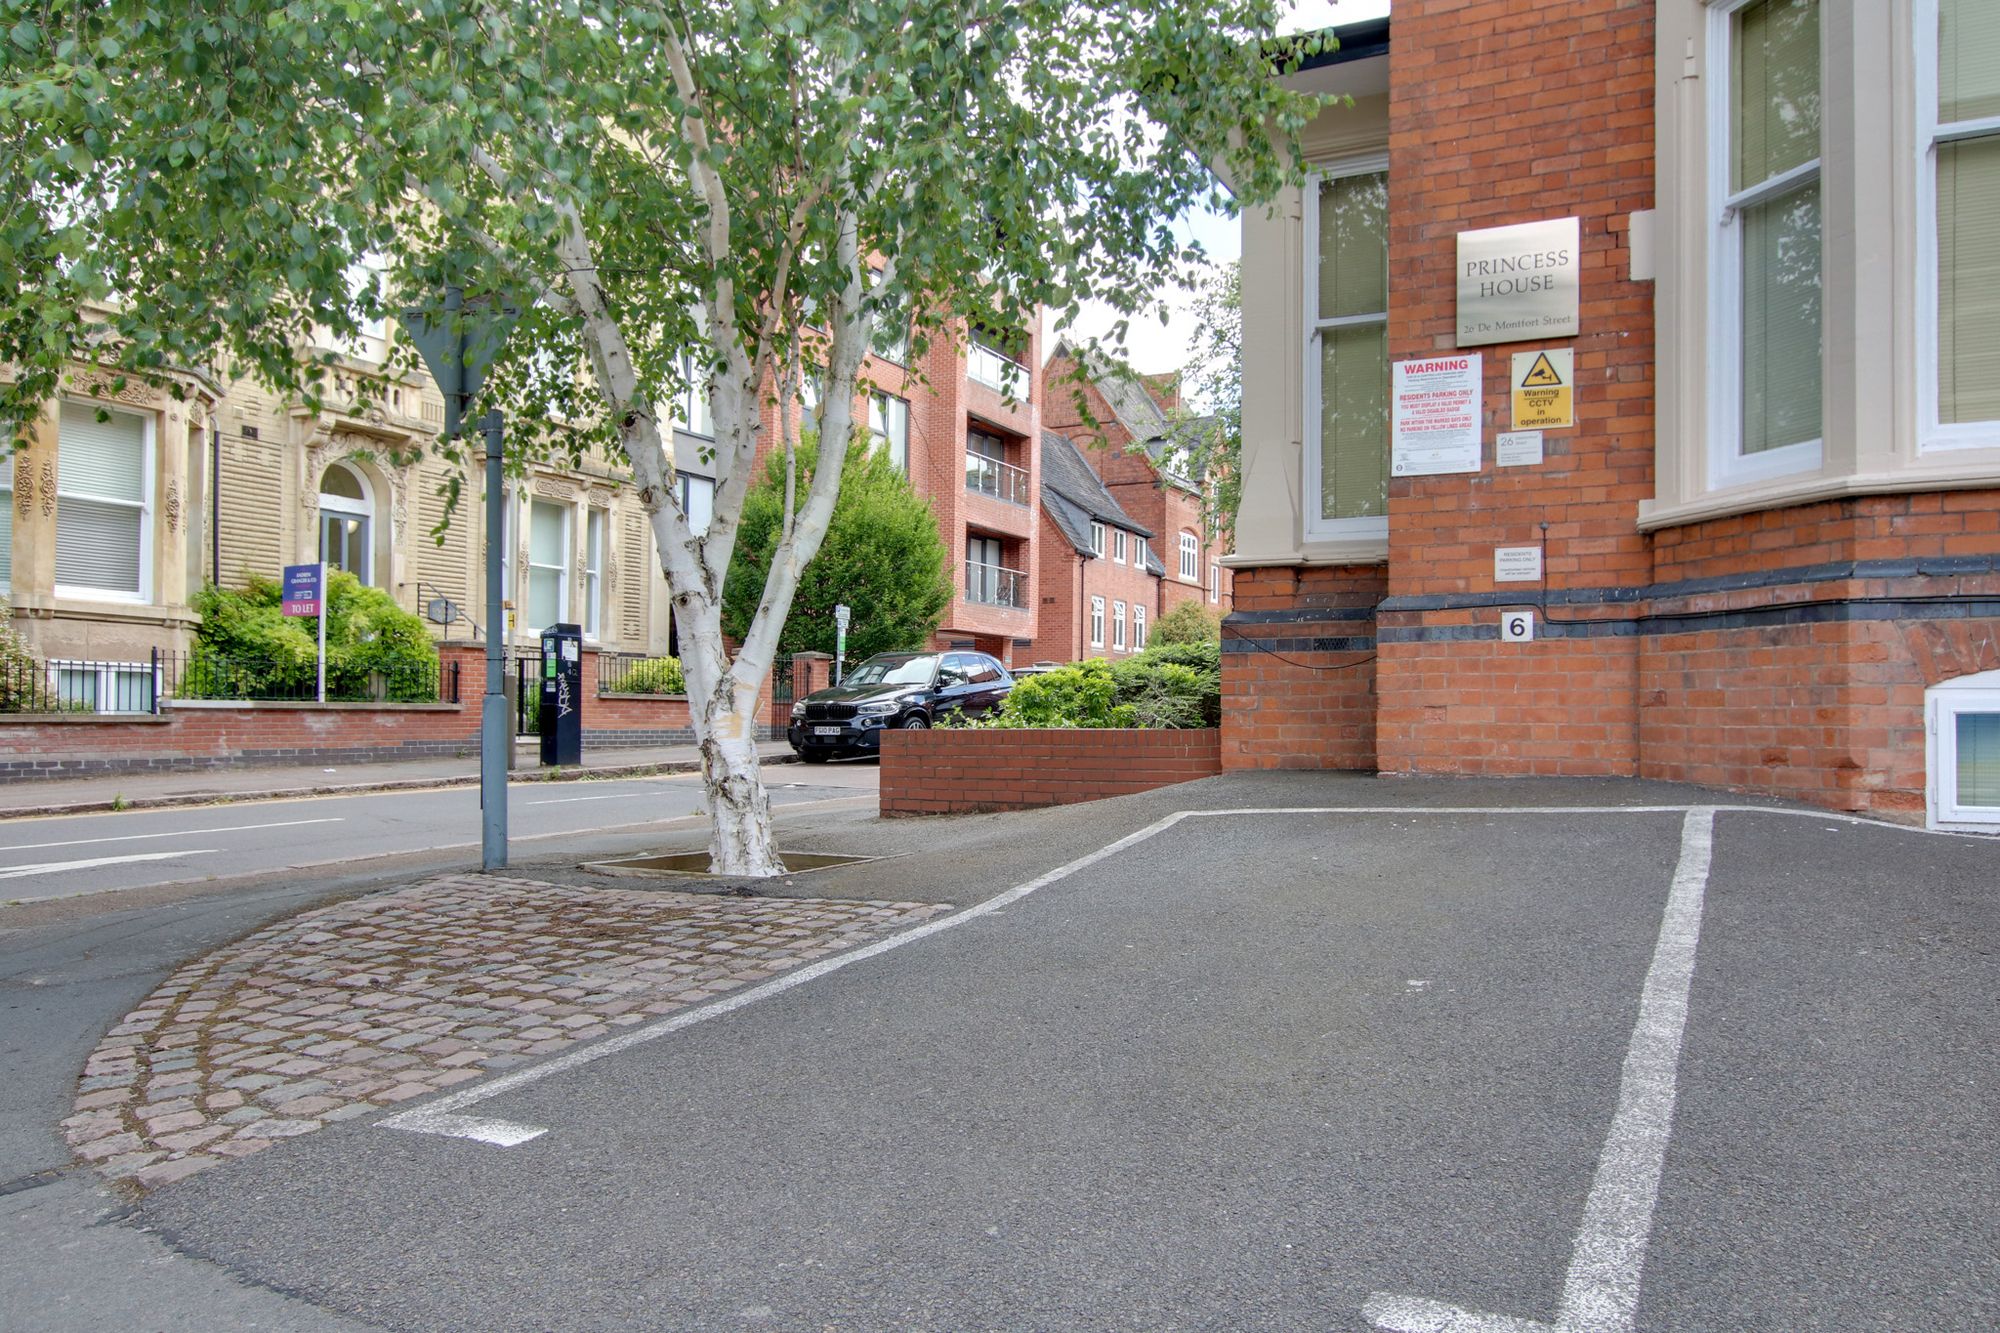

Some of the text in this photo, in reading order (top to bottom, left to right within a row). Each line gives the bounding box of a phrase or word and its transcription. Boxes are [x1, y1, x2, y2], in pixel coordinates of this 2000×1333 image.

[1467, 249, 1569, 277] PRINCESS
[1480, 274, 1554, 298] HOUSE
[1478, 322, 1492, 333] De
[1495, 317, 1540, 330] Montfort
[1543, 314, 1571, 326] Street
[1404, 359, 1469, 374] WARNING
[1399, 392, 1431, 401] RESIDENTS
[1432, 390, 1457, 398] PARKING
[1523, 388, 1560, 398] Warning
[1529, 399, 1554, 408] CCTV
[1537, 408, 1545, 416] in
[1520, 416, 1562, 426] operation
[1500, 436, 1514, 447] 26
[291, 603, 314, 614] TO LET
[1510, 617, 1525, 637] 6
